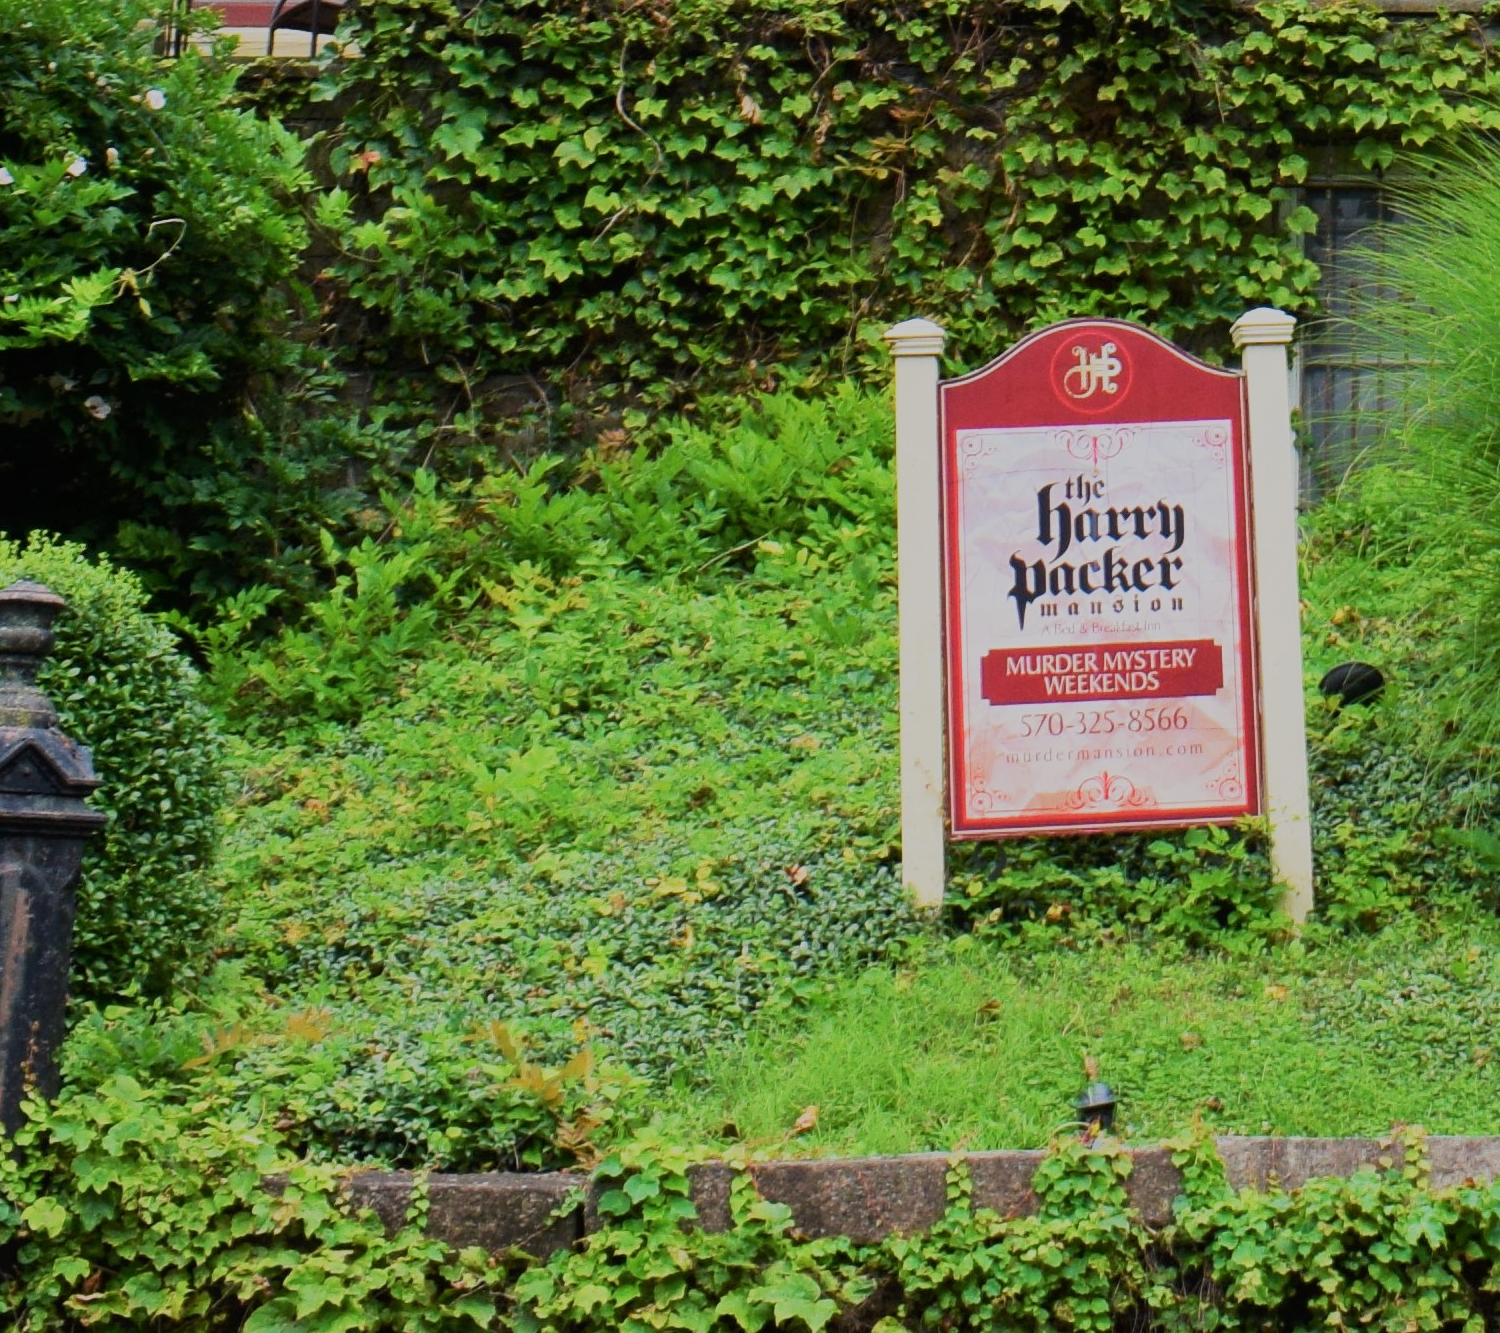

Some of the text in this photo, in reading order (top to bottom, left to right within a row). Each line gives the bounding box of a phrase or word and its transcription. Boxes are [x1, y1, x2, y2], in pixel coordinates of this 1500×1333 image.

[1065, 474, 1105, 506] the
[1036, 482, 1185, 564] harry
[1007, 546, 1183, 631] packer
[1040, 594, 1183, 616] mansion
[1006, 648, 1197, 676] MURDER MYSTERY
[1044, 671, 1160, 695] WEEKENDS
[1021, 707, 1188, 737] 570-325-8566
[1006, 741, 1204, 764] murdermansion.com
